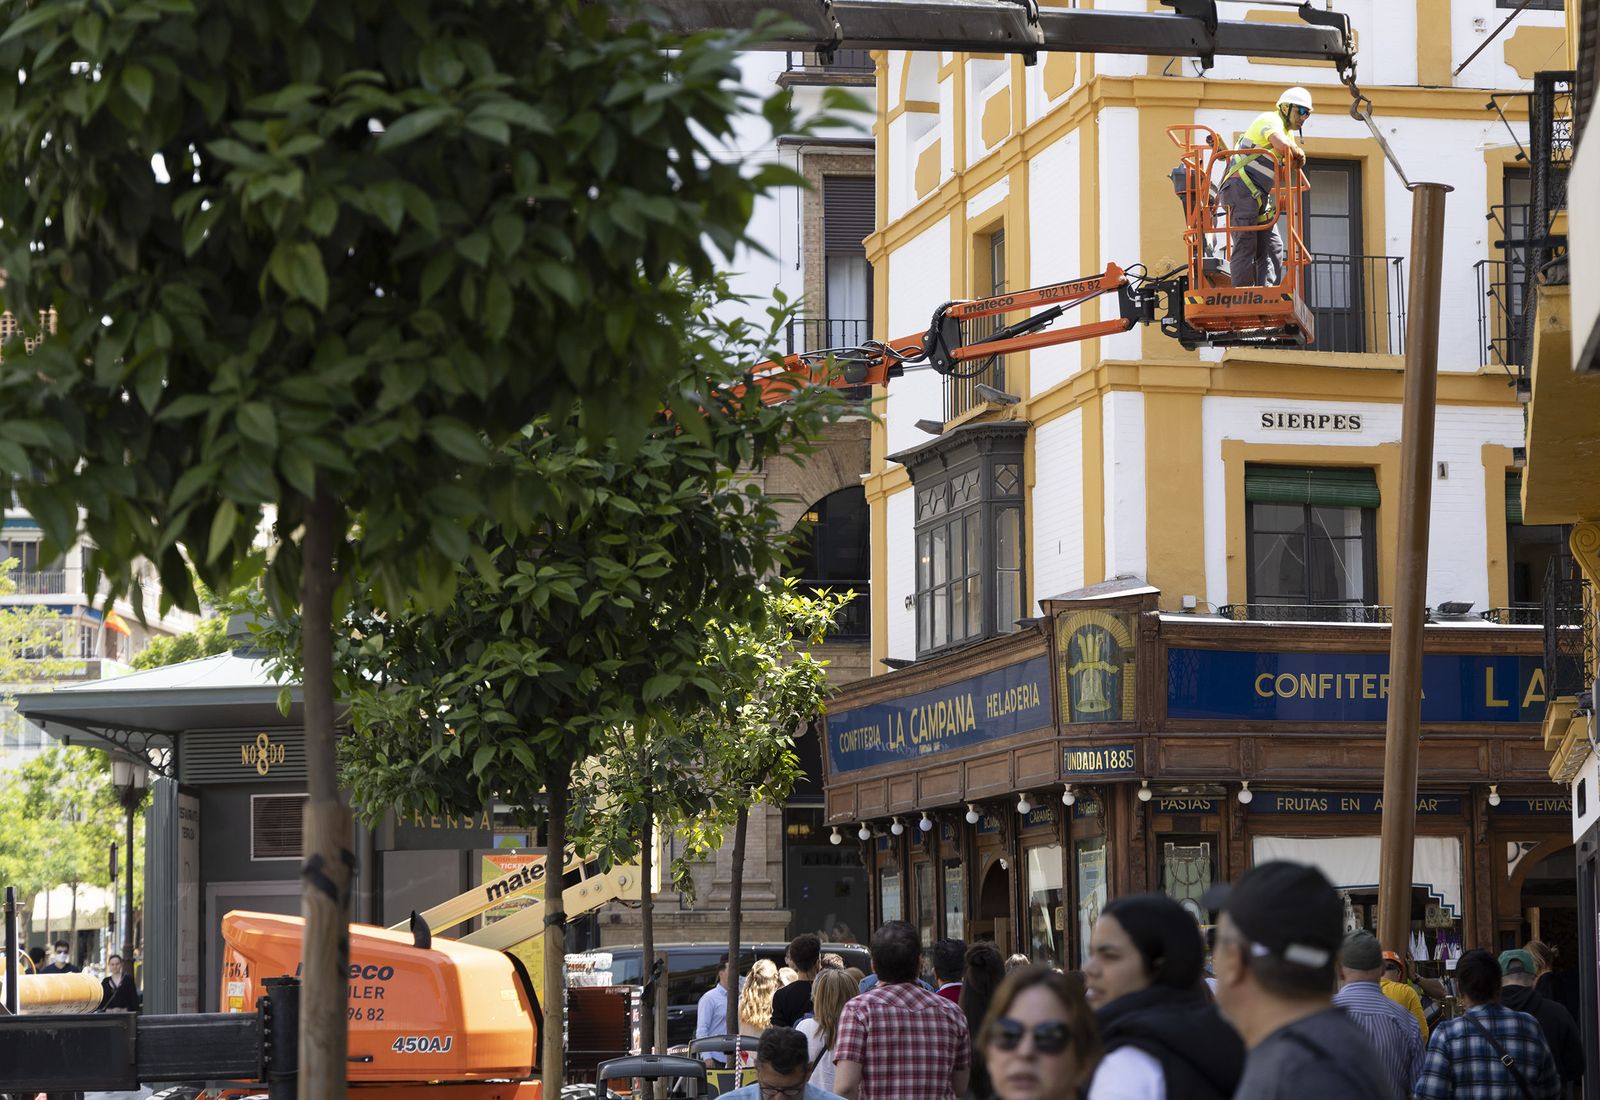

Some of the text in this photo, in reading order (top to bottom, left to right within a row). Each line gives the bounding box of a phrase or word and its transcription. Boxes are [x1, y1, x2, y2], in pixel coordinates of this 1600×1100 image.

[963, 296, 1014, 314] mateco
[1038, 287, 1058, 299] 902
[1072, 282, 1084, 293] 96
[1087, 280, 1101, 290] 82
[1206, 291, 1279, 308] alquila...
[1261, 413, 1361, 430] SIERPES
[1254, 666, 1546, 708] CONFITER LA
[888, 711, 905, 749] LA
[910, 693, 977, 744] CAMPANA
[986, 682, 1040, 718] HELADERIA
[1064, 750, 1134, 770] FUNDADA 1885
[1160, 800, 1211, 810] PASTAS
[1276, 798, 1328, 811] FRUTAS
[1341, 798, 1360, 811] EN
[367, 1008, 384, 1021] 82
[392, 1036, 453, 1053] 450AJ
